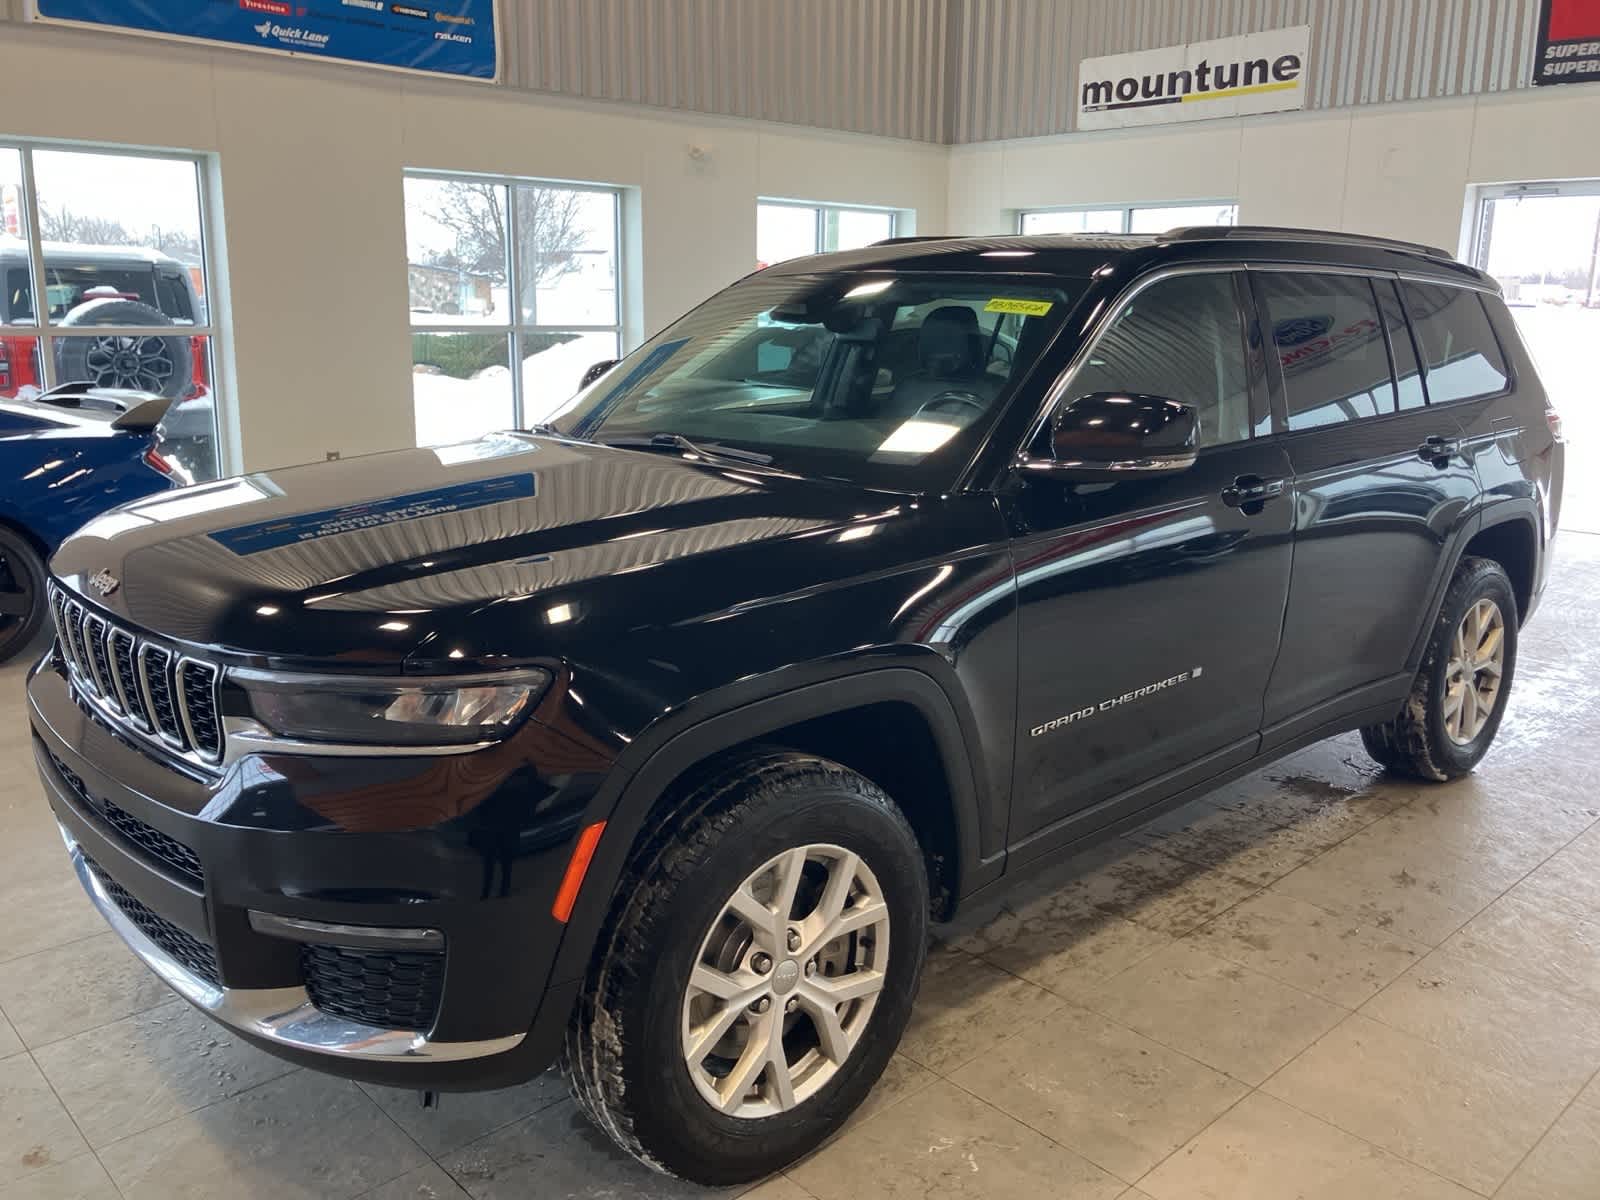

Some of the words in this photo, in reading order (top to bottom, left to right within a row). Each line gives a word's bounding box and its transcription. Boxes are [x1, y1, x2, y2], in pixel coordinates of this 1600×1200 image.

[271, 25, 302, 38] Quick
[302, 30, 329, 43] Lane
[1082, 54, 1301, 106] mountune
[1031, 706, 1095, 737] GRAND
[1099, 672, 1189, 712] CHEROKEE
